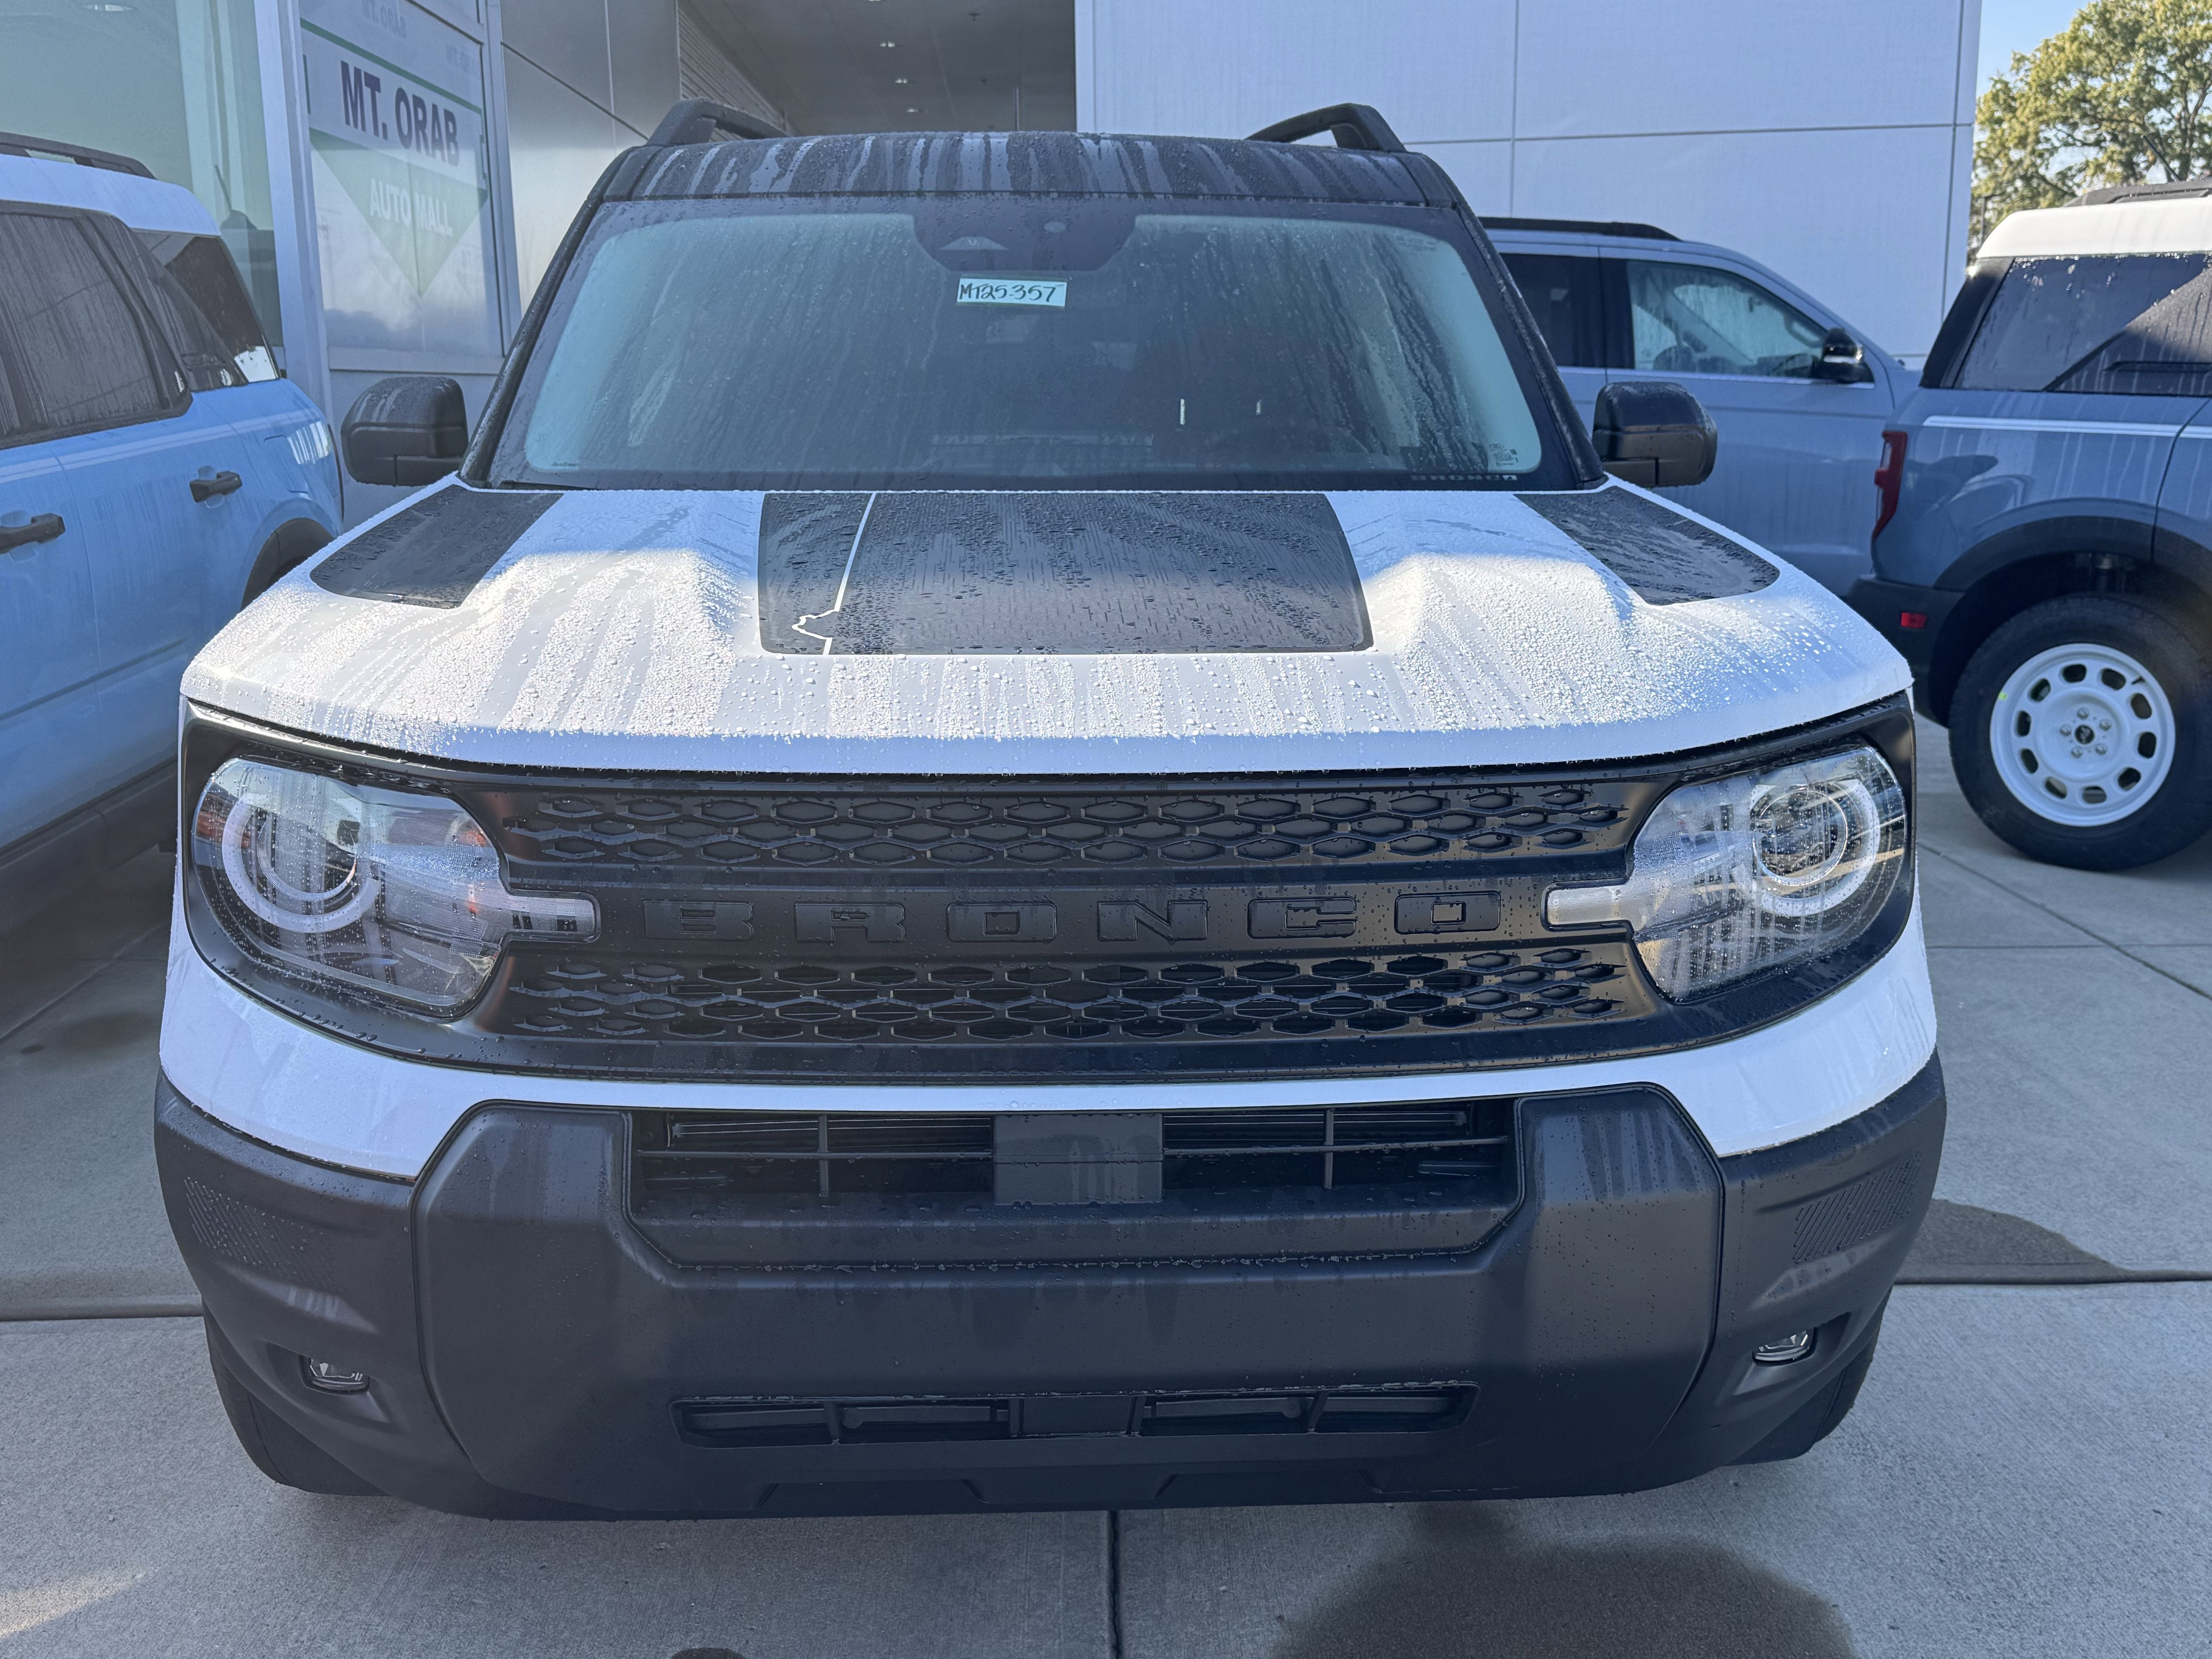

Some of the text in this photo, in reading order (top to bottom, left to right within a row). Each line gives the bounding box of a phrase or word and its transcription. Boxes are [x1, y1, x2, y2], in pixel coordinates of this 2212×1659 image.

[340, 60, 460, 167] MT. ORAB
[370, 178, 453, 236] AUTO MALL
[958, 283, 1056, 303] MT25-357
[643, 891, 1503, 944] BRONCO
